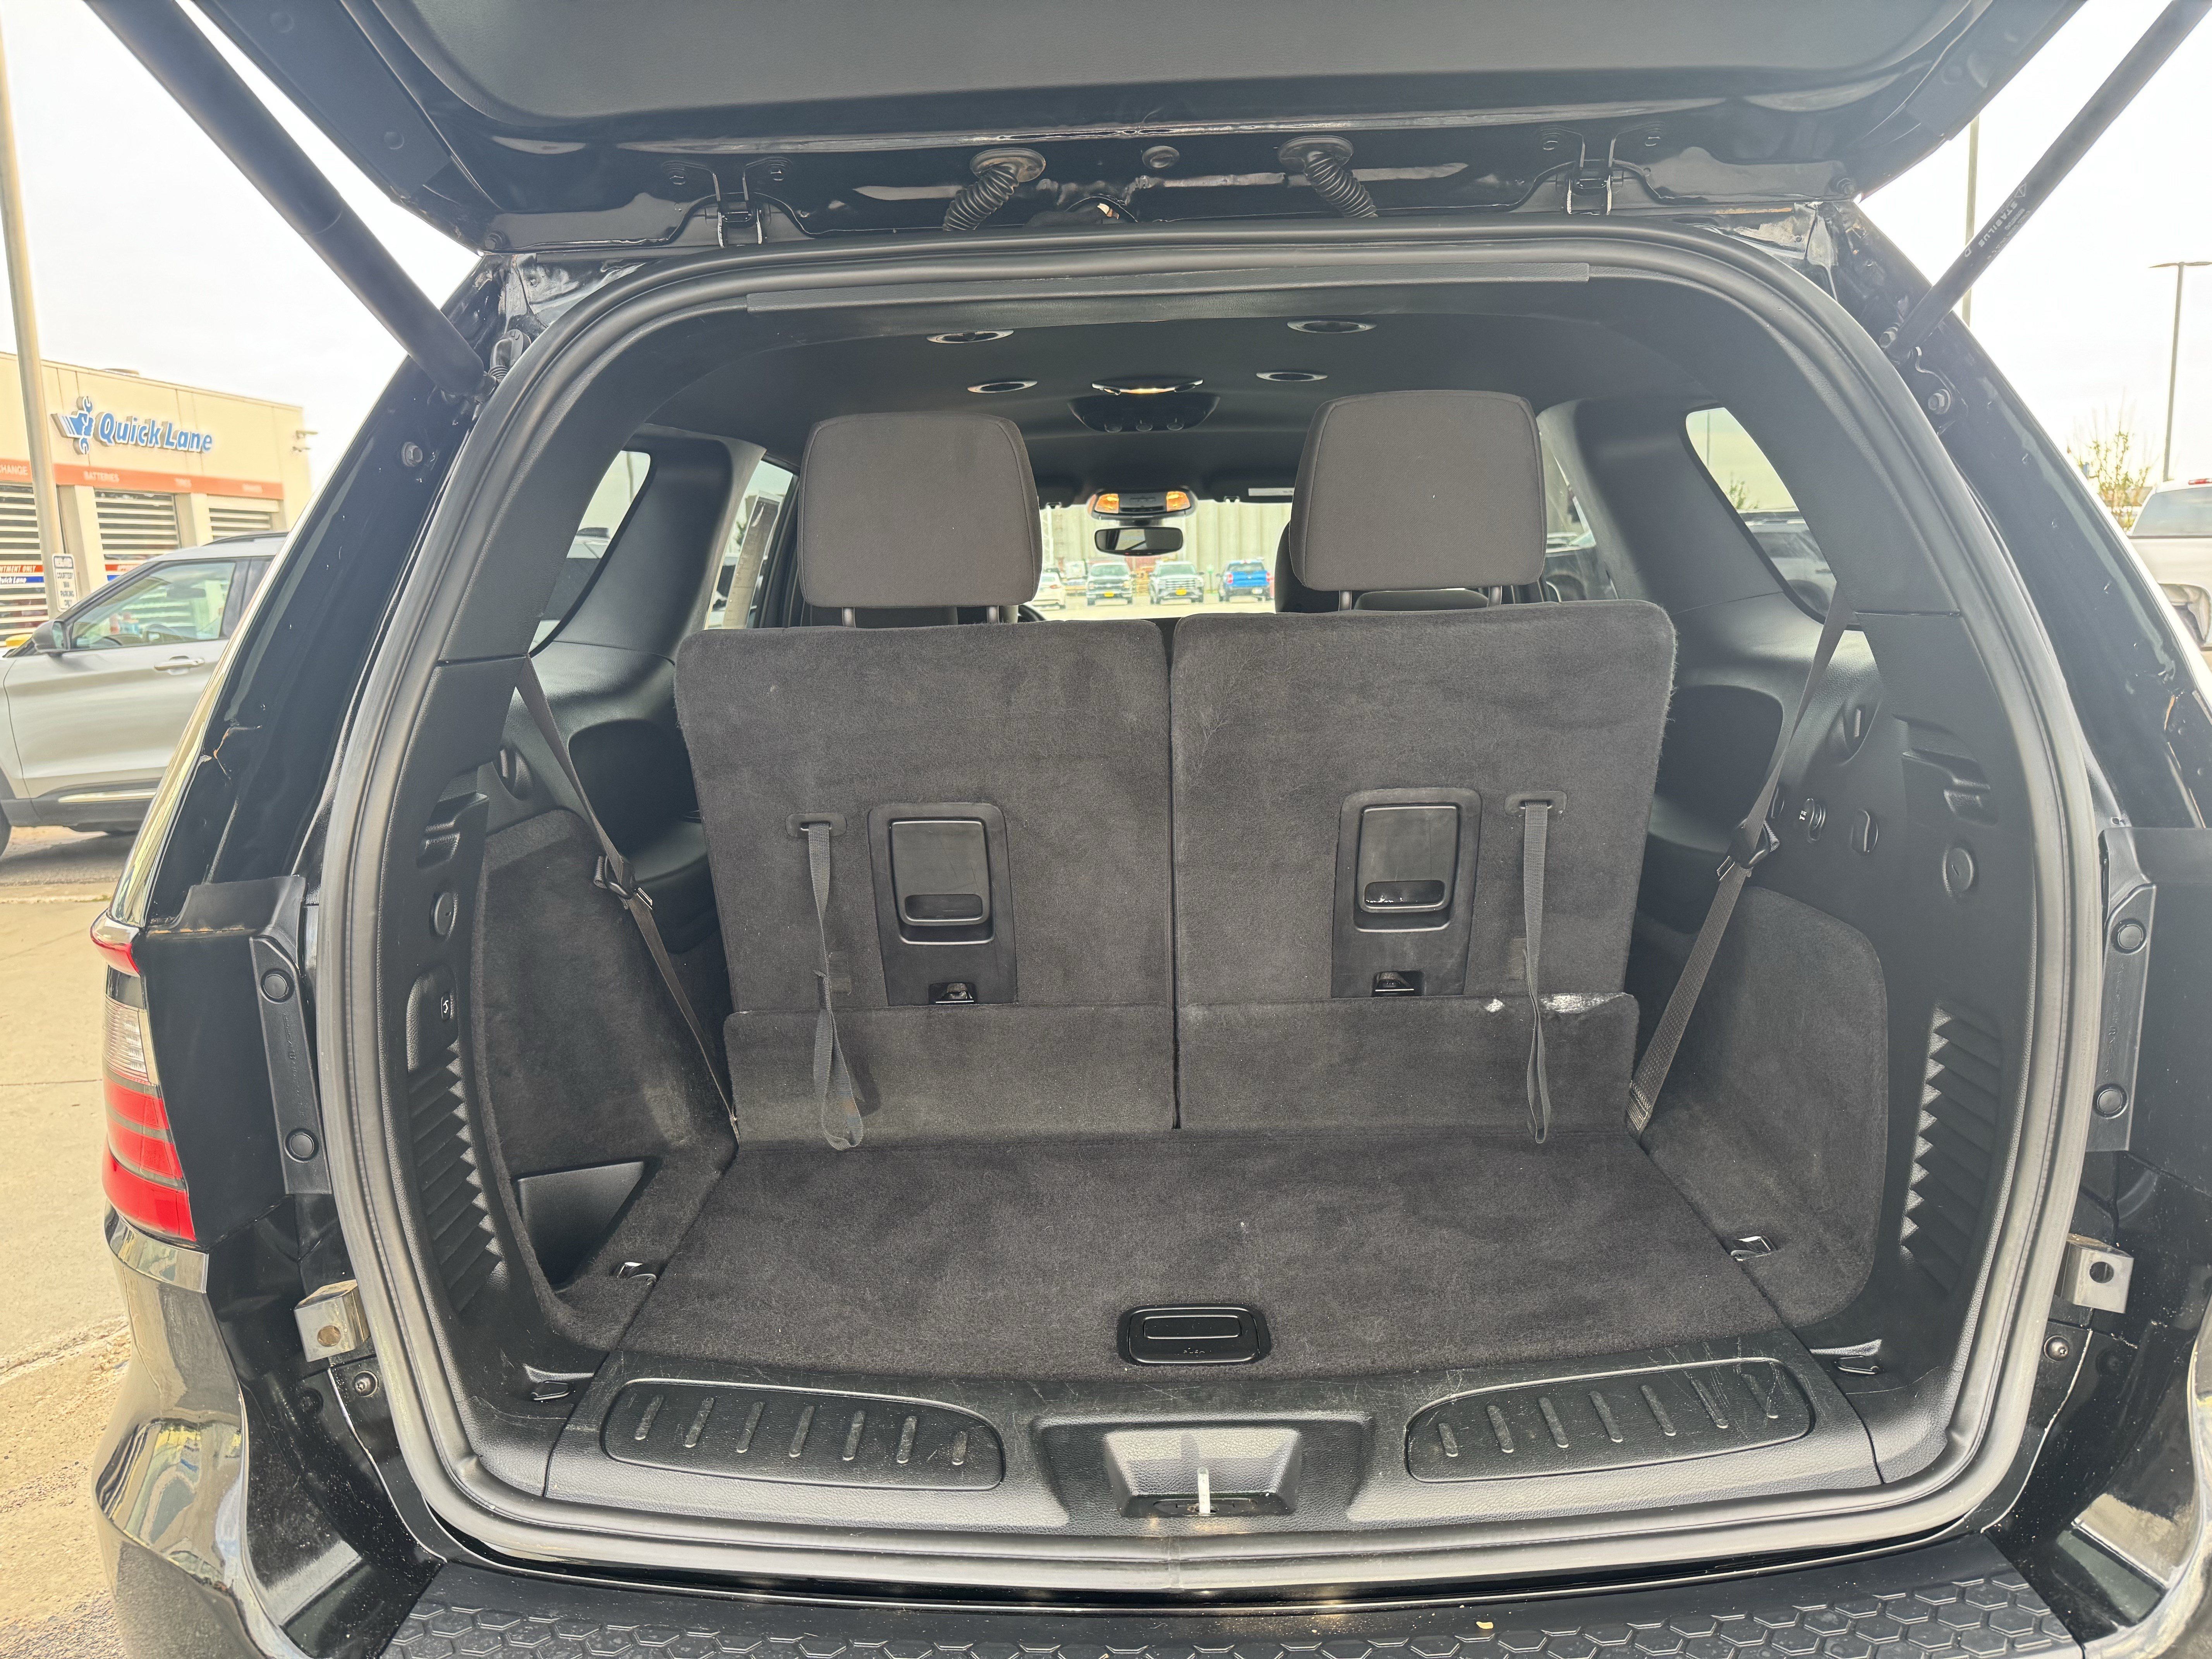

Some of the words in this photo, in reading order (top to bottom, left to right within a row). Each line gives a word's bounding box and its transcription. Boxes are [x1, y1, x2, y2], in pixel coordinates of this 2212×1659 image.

[1978, 201, 2018, 247] STABILUS
[100, 412, 162, 446] Quick
[164, 422, 213, 452] Lane
[0, 465, 29, 476] HANGE
[83, 471, 120, 483] BATTERIES
